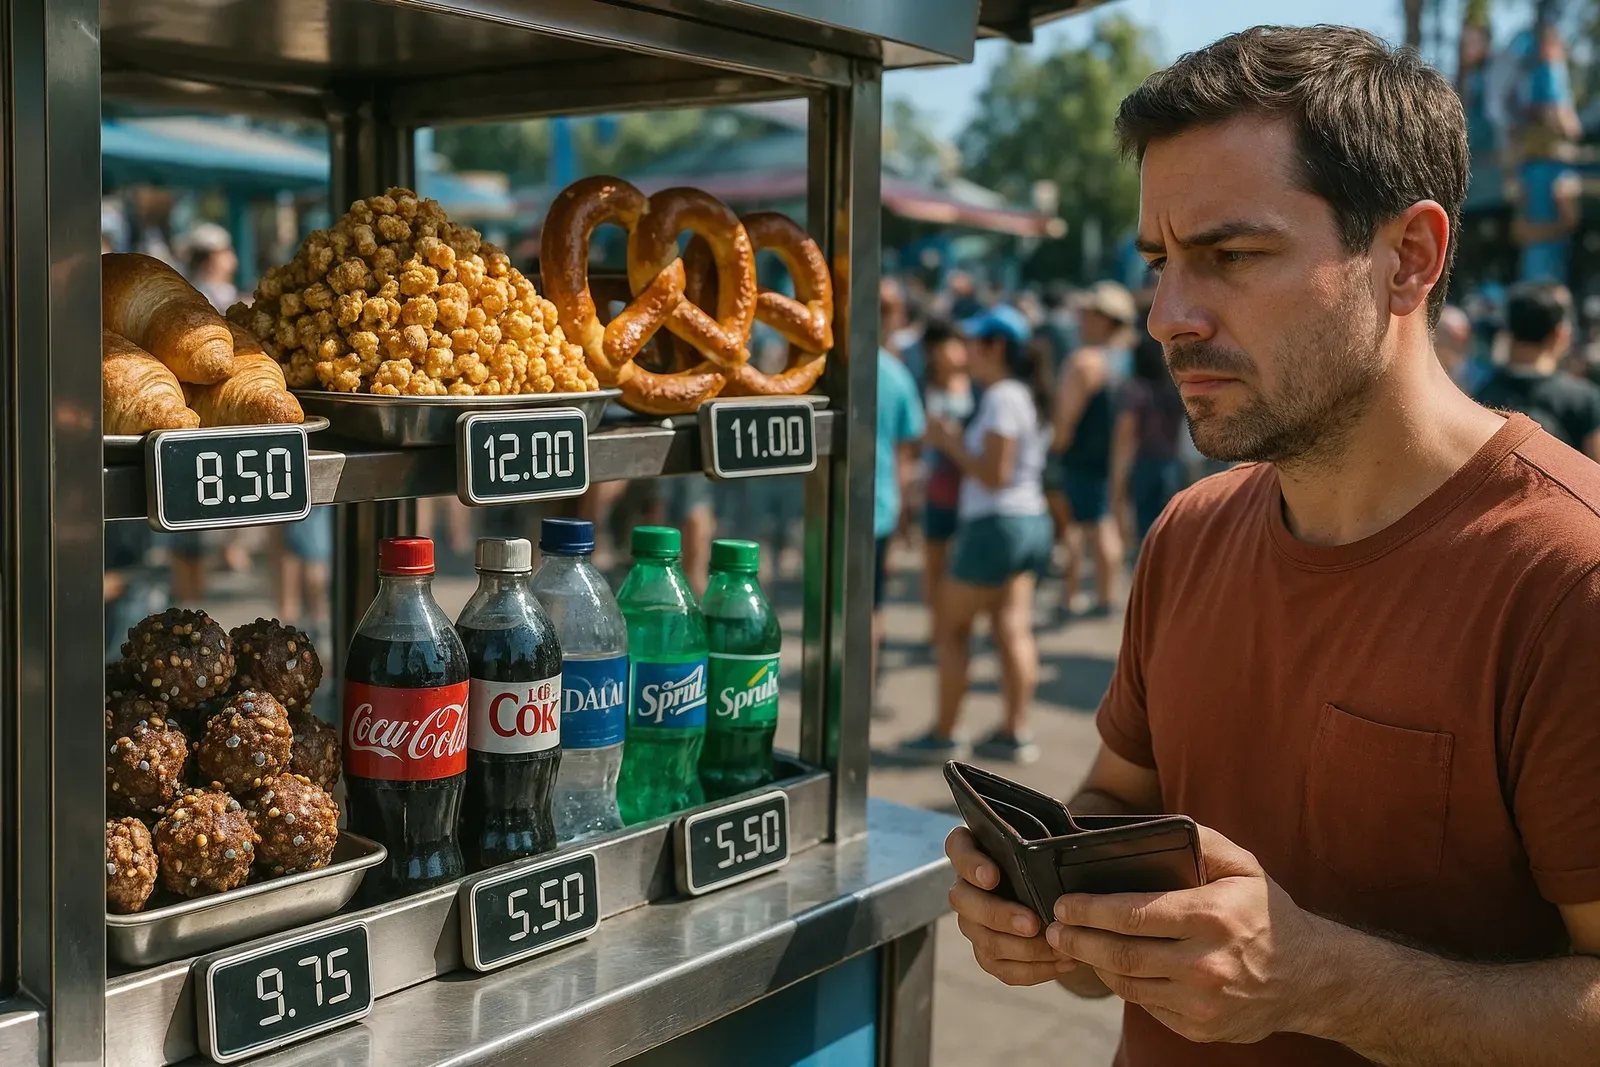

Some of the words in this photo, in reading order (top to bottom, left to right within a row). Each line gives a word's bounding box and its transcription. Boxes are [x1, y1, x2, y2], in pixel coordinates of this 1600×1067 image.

[483, 430, 574, 483] 12.00
[731, 416, 805, 459] 11.00
[196, 447, 292, 505] 8.50
[716, 809, 780, 869] 5.50
[508, 872, 584, 942] 5.50
[256, 947, 352, 1027] 9.75
